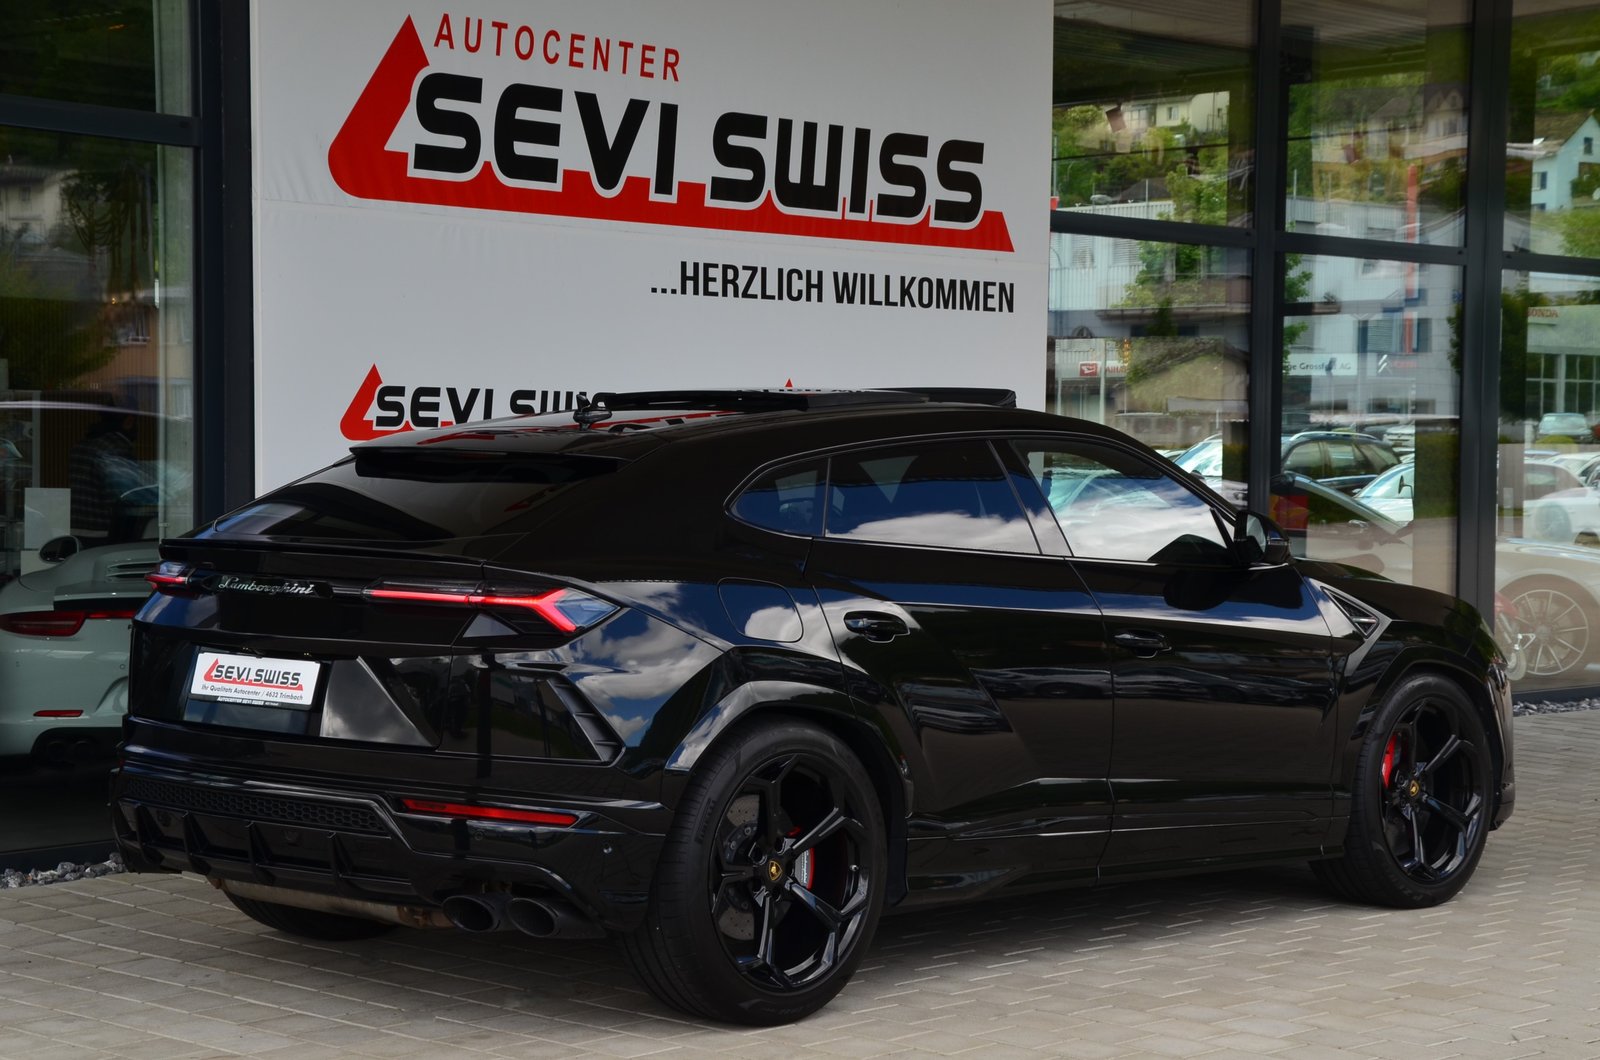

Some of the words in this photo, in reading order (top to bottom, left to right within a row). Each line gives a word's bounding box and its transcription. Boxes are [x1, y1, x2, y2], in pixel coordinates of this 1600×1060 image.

[433, 13, 680, 82] AUTOCENTER
[413, 72, 679, 197] SEVI
[710, 112, 985, 224] SWISS
[650, 260, 823, 304] ...HERZLICH
[832, 271, 1015, 313] WILLKOMMEN
[375, 385, 494, 428] SEVI
[218, 575, 316, 595] Lamborghini
[214, 665, 251, 681] SEVI
[253, 668, 301, 686] SWISS
[233, 688, 261, 697] Autocenter
[279, 692, 304, 701] Trimbach
